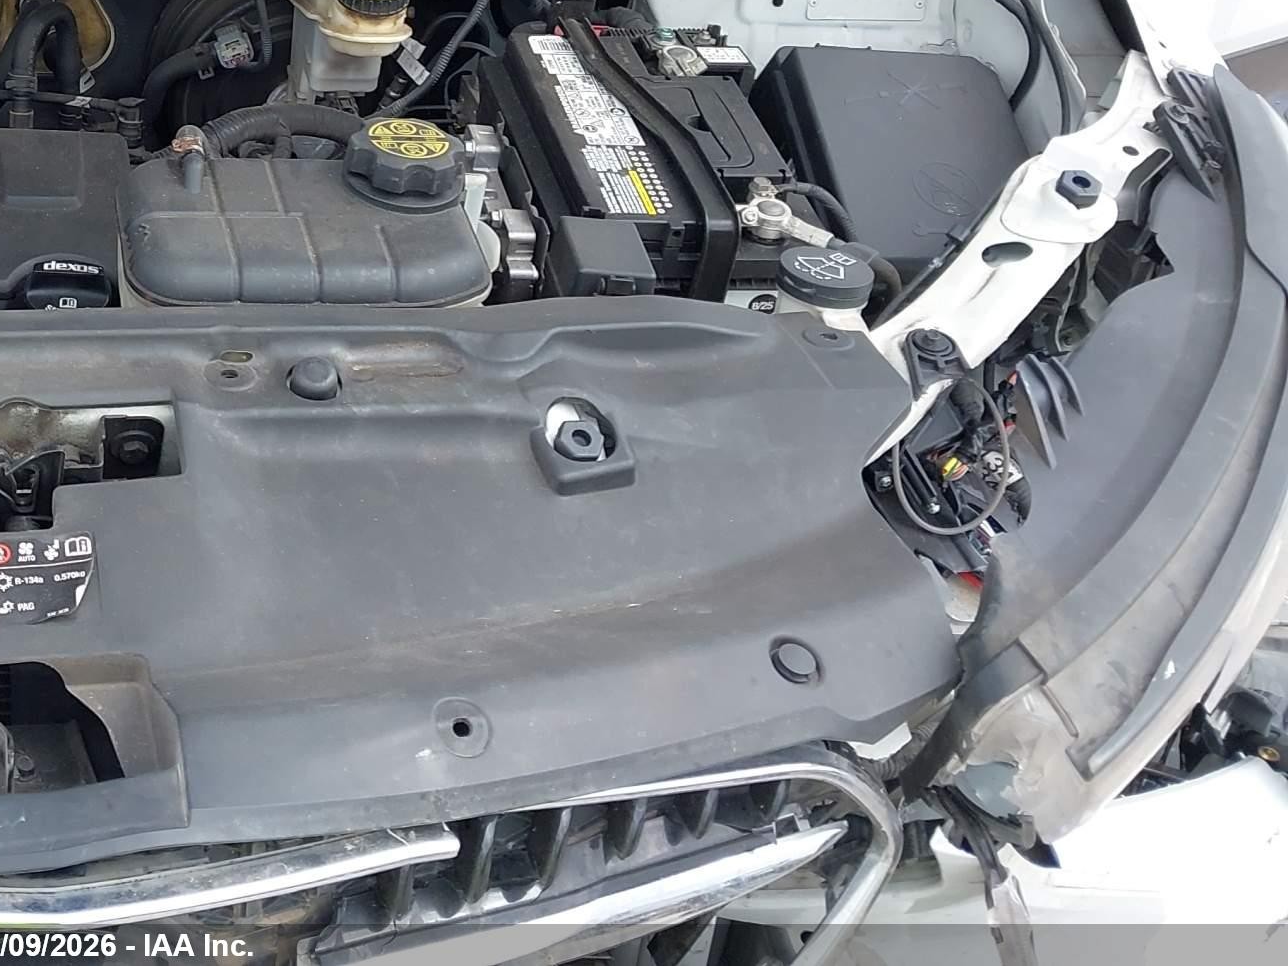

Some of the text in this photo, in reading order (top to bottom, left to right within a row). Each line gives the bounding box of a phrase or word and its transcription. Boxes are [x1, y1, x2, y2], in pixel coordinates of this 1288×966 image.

[43, 260, 100, 275] dexos
[18, 554, 36, 562] AUTO
[14, 576, 45, 585] R-134a
[17, 602, 36, 612] PAG
